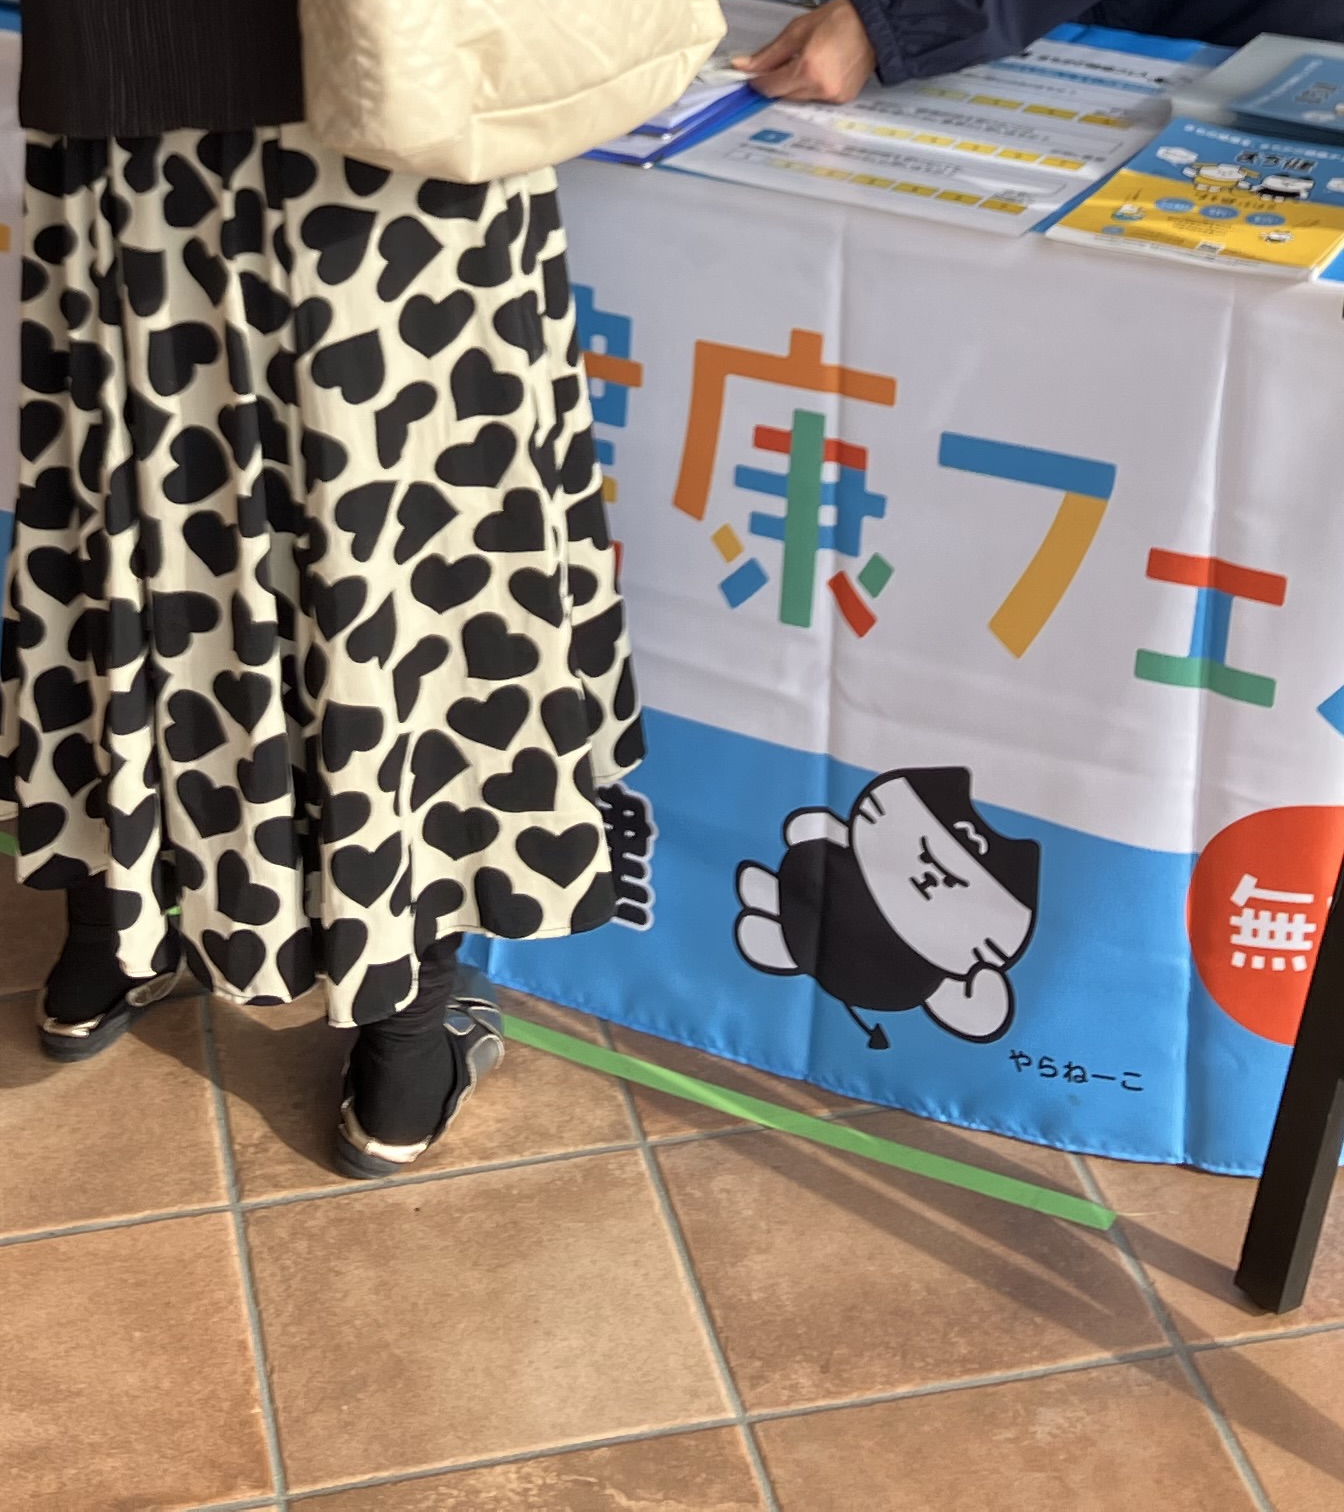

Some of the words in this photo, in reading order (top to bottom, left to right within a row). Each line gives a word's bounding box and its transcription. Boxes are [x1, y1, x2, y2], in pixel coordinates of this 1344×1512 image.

[1008, 1047, 1145, 1093] やらねーこ
